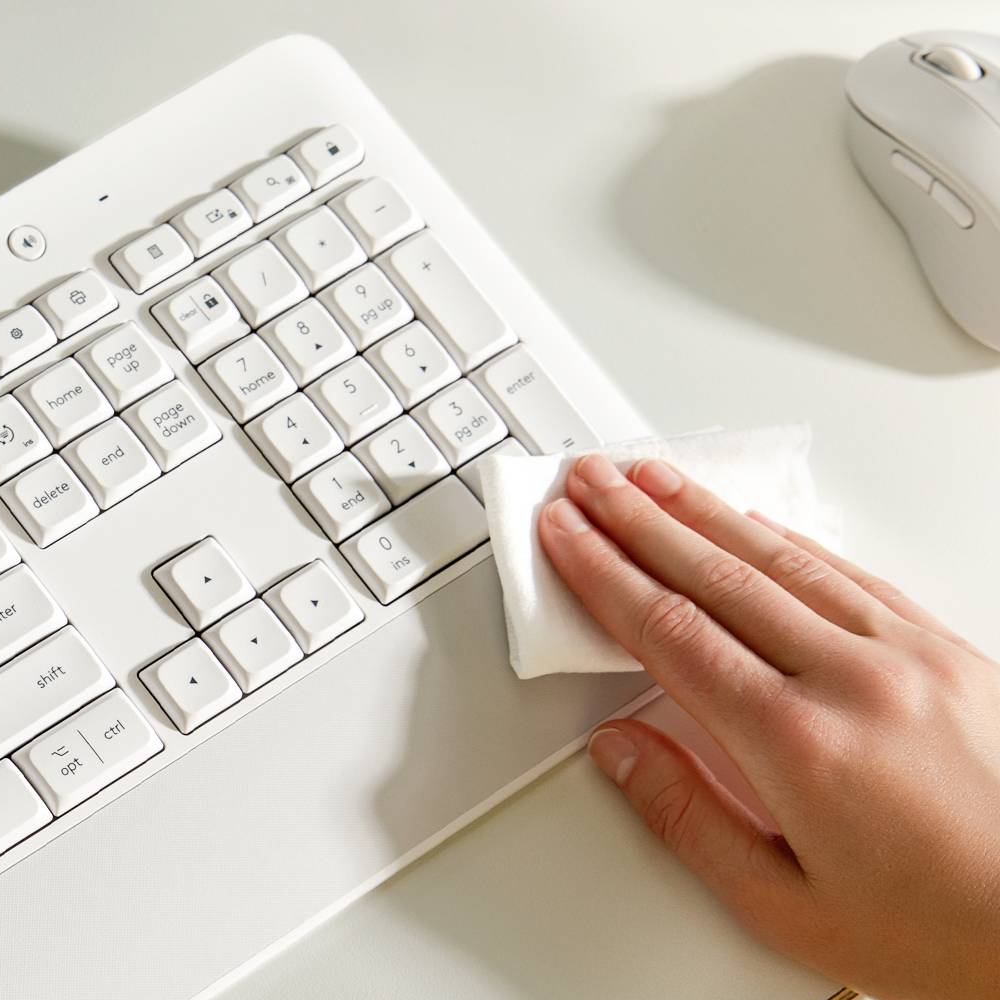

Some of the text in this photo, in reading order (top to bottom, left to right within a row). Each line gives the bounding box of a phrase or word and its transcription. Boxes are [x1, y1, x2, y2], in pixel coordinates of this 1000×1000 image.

[355, 284, 367, 298] 9
[361, 297, 394, 325] pg up
[296, 321, 310, 335] 8
[106, 341, 137, 367] page
[404, 343, 416, 358] 6
[124, 357, 140, 374] up
[235, 356, 247, 372] 7
[238, 370, 276, 396] home
[343, 379, 357, 394] 5
[506, 372, 535, 395] enter
[46, 385, 83, 409] home
[153, 401, 184, 427] page
[448, 401, 463, 417] 3
[162, 413, 195, 438] down
[287, 416, 297, 429] 4
[454, 412, 488, 442] pg dn
[101, 445, 125, 466] end
[390, 439, 405, 454] 2
[331, 477, 343, 489] 1
[32, 482, 70, 509] delete
[340, 491, 364, 511] end
[378, 536, 393, 551] 0
[390, 556, 411, 571] ins
[36, 666, 66, 689] shift
[103, 719, 126, 740] ctrl
[60, 756, 83, 776] opt
